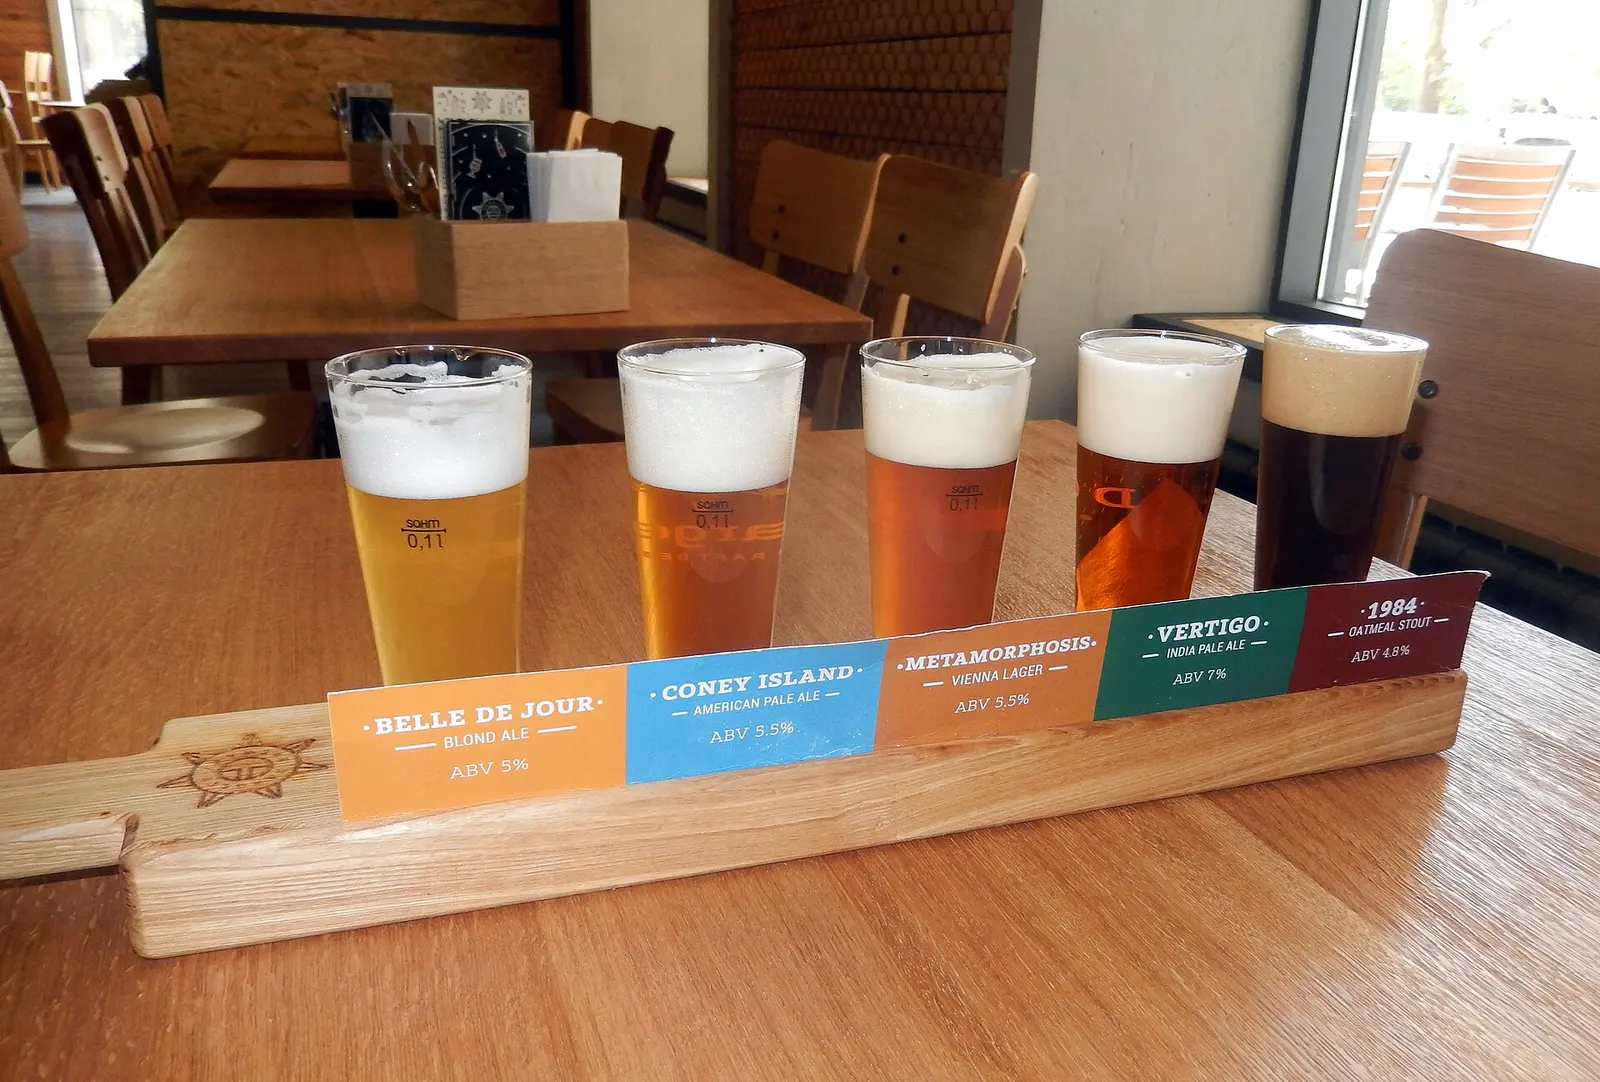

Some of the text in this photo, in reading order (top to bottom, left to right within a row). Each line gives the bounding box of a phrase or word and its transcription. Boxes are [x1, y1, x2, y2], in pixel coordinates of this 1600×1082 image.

[1367, 597, 1418, 620] 1984
[1156, 615, 1261, 643] VERTIGO
[1348, 616, 1433, 637] OATMEAL STOUT
[905, 635, 1092, 671] METAMORPHOSIS
[1166, 639, 1246, 659] INDIA PALE ALE
[1350, 645, 1410, 663] ABV 4.8%
[662, 665, 855, 701] CONEY ISLAND
[952, 664, 1044, 687] VIENNA LAGER
[1172, 668, 1227, 686] ABV 7%
[693, 690, 821, 716] AMERICAN PALE ALE
[954, 693, 1030, 714] ABV 5.5%
[374, 696, 595, 735] BELLE DE JOUR
[444, 727, 529, 749] BLOND ALE
[709, 721, 795, 744] ABV 5.5%
[449, 757, 529, 780] ABV 5%
